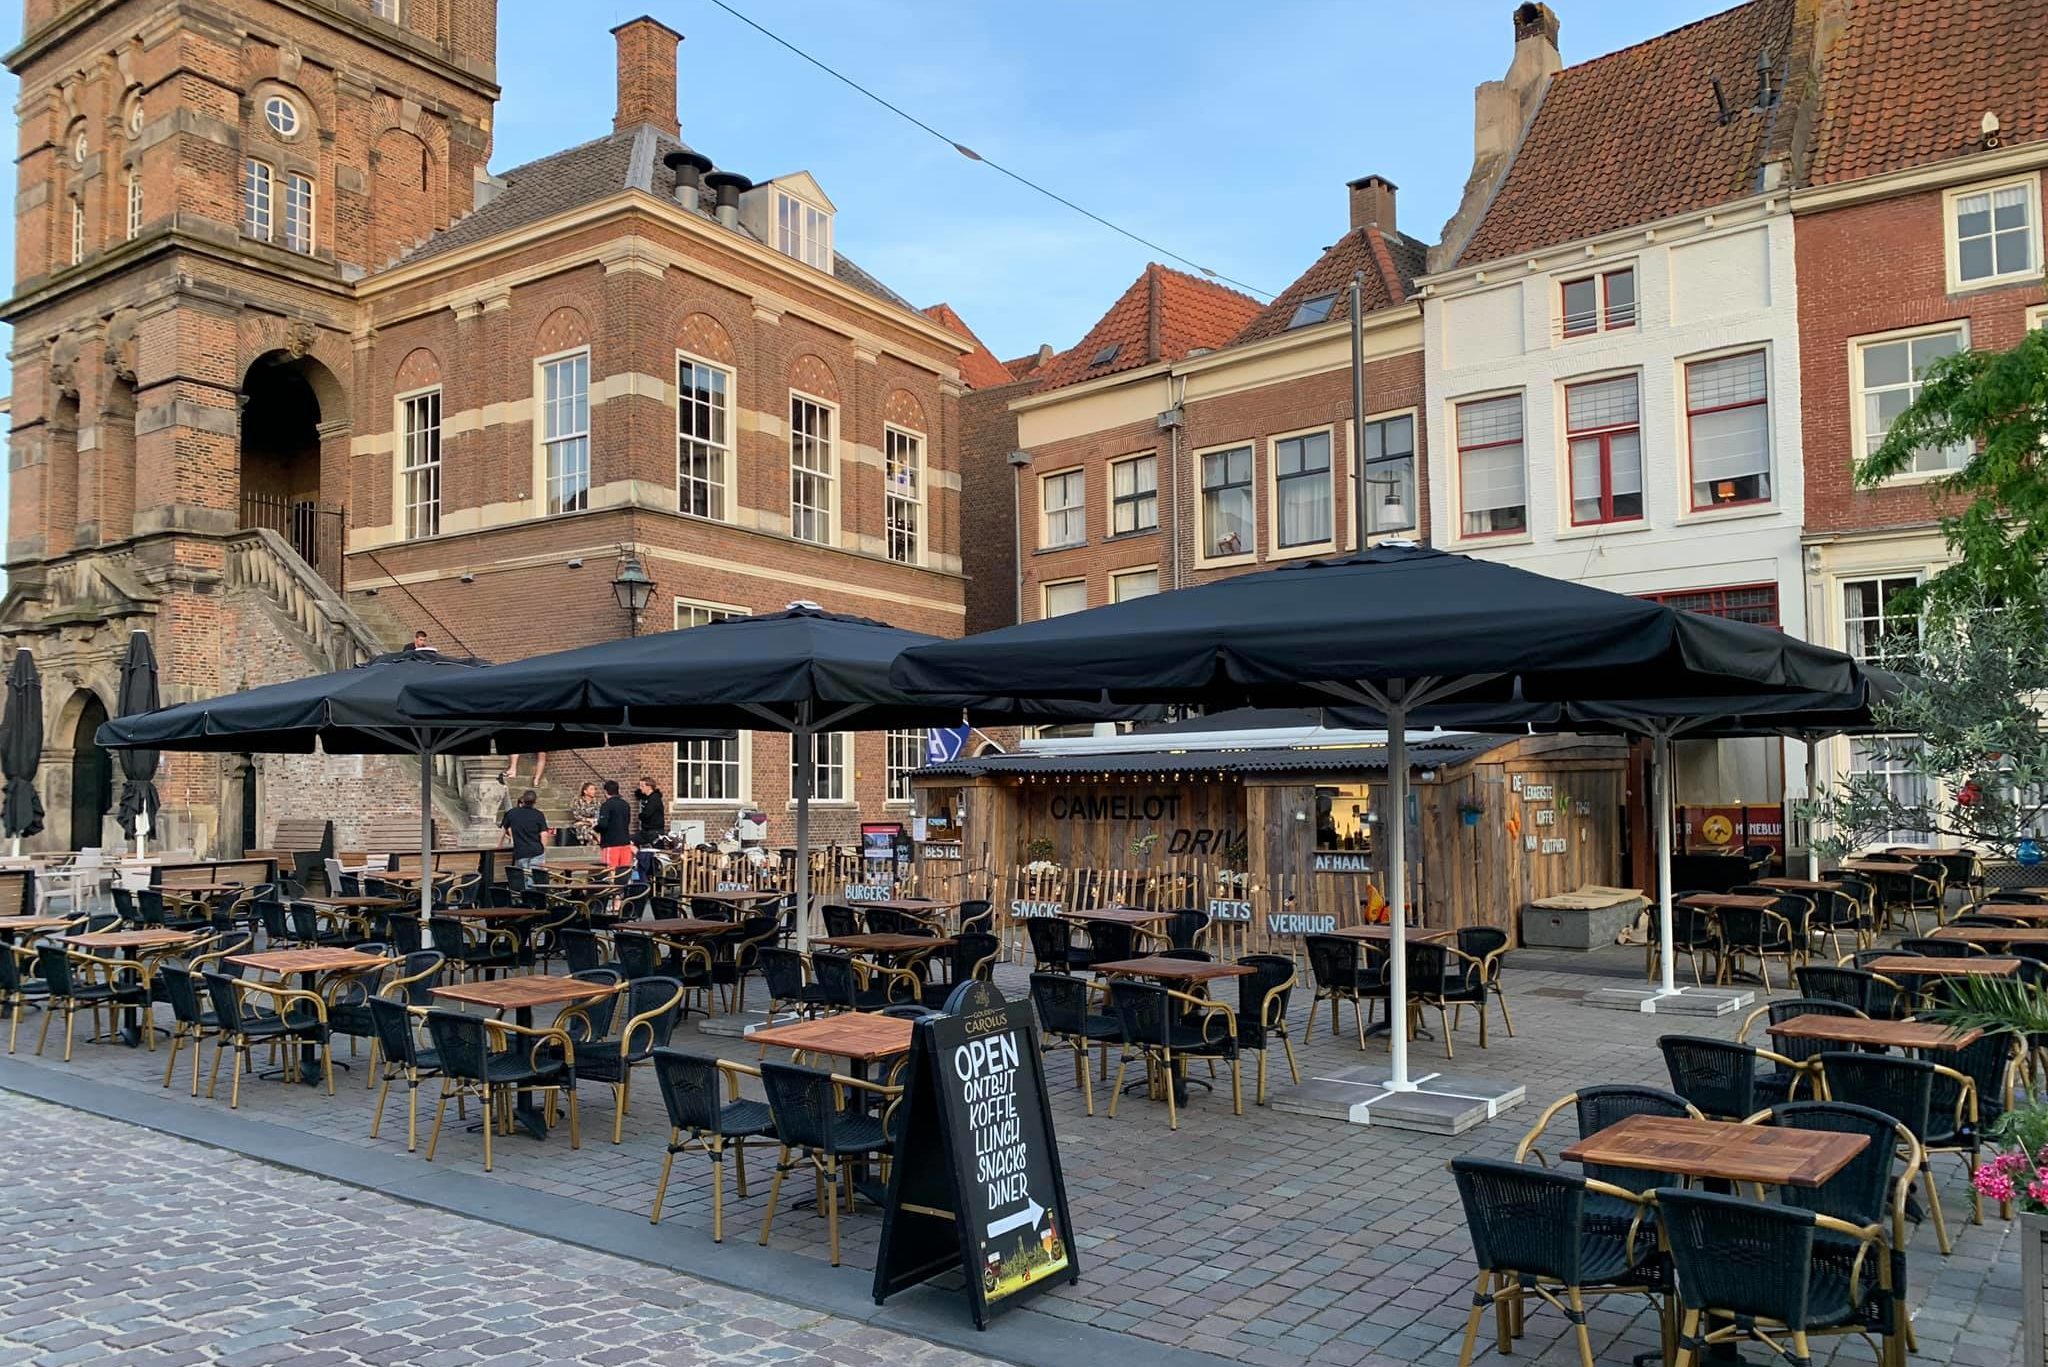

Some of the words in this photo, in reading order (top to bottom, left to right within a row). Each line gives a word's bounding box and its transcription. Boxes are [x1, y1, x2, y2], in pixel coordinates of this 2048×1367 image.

[1513, 775, 1522, 792] DE
[1523, 785, 1553, 801] LEKKERSTE
[1050, 796, 1181, 821] CAMELOT
[1735, 823, 1782, 835] MNEBLU
[925, 845, 961, 858] BESTEL
[1541, 838, 1567, 854] ZUTPHEN
[1315, 855, 1370, 870] AFHAAL
[845, 885, 891, 900] BURGERS
[1011, 901, 1062, 918] SNACKS
[1209, 900, 1250, 918] FIETS
[1268, 914, 1336, 933] VERHUUR
[964, 1013, 1008, 1034] CAROLUS
[954, 1031, 1020, 1082] OPEN
[969, 1092, 1018, 1131] KOFFIE
[975, 1116, 1020, 1156] LUNCH
[976, 1142, 1027, 1183] SNACKS
[988, 1172, 1029, 1211] DINER
